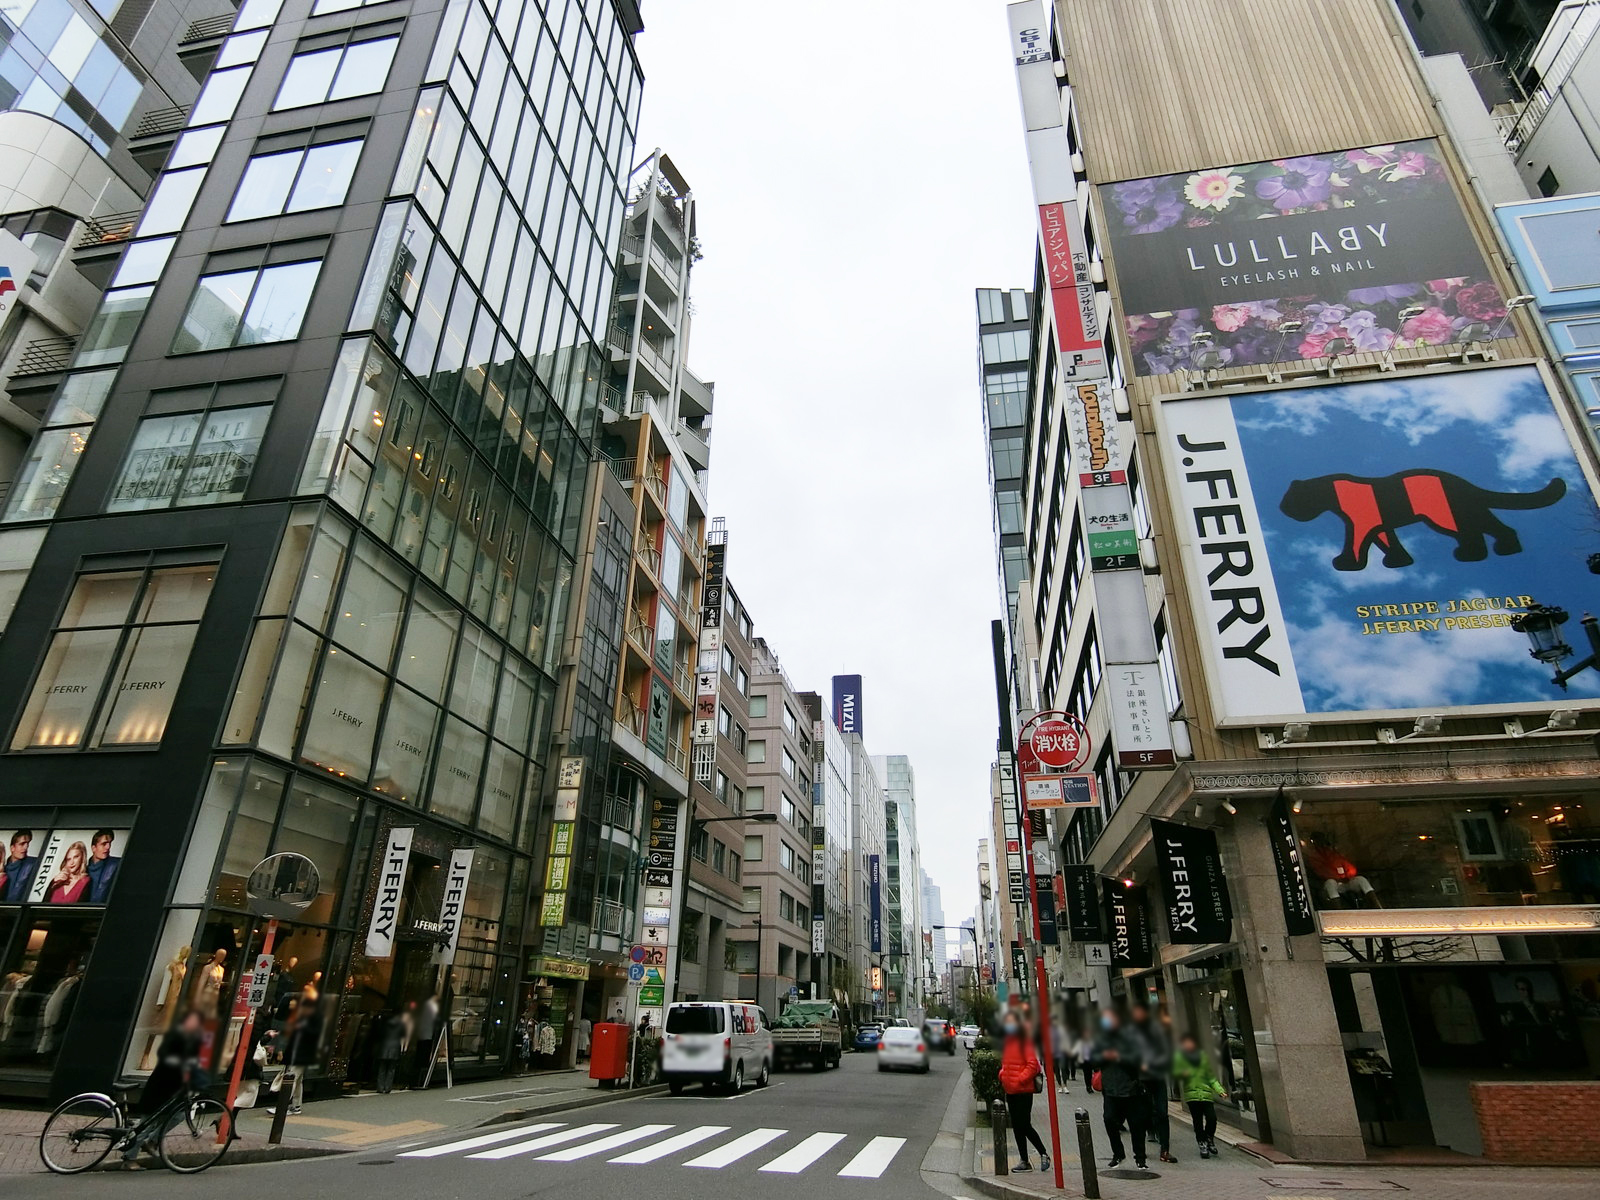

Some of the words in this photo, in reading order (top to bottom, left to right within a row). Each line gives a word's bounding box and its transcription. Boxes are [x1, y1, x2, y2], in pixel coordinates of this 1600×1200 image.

[1045, 207, 1070, 284] ピュアジャパン
[1220, 268, 1299, 287] EYELASH
[1310, 265, 1321, 276] &
[1331, 259, 1375, 273] NAIL
[1094, 474, 1110, 483] 3F
[1088, 513, 1129, 524] 犬の生活
[1105, 556, 1126, 567] 2F
[1176, 433, 1280, 677] J.FERRY
[1356, 601, 1440, 618] STRIPE
[1446, 595, 1533, 613] JAGUAR
[1362, 618, 1441, 635] J.FERRY
[45, 685, 88, 694] J.FERRY
[119, 680, 166, 691] J.FERRY
[331, 707, 363, 728] J.FERRY
[843, 694, 855, 733] MIZU
[396, 739, 422, 757] J.FERRY
[1035, 733, 1077, 752] 消火栓
[1139, 753, 1154, 762] 5F
[448, 765, 471, 781] J.FERRY
[34, 836, 61, 896] J.FERRY
[1205, 855, 1216, 887] GINZA
[374, 842, 406, 941] J.FERRY
[1166, 839, 1198, 933] J.FERRY
[413, 919, 444, 932] J.FERRY
[1112, 892, 1130, 960] J.FERRY
[1169, 906, 1181, 932] MEN
[249, 973, 268, 1003] 注意
